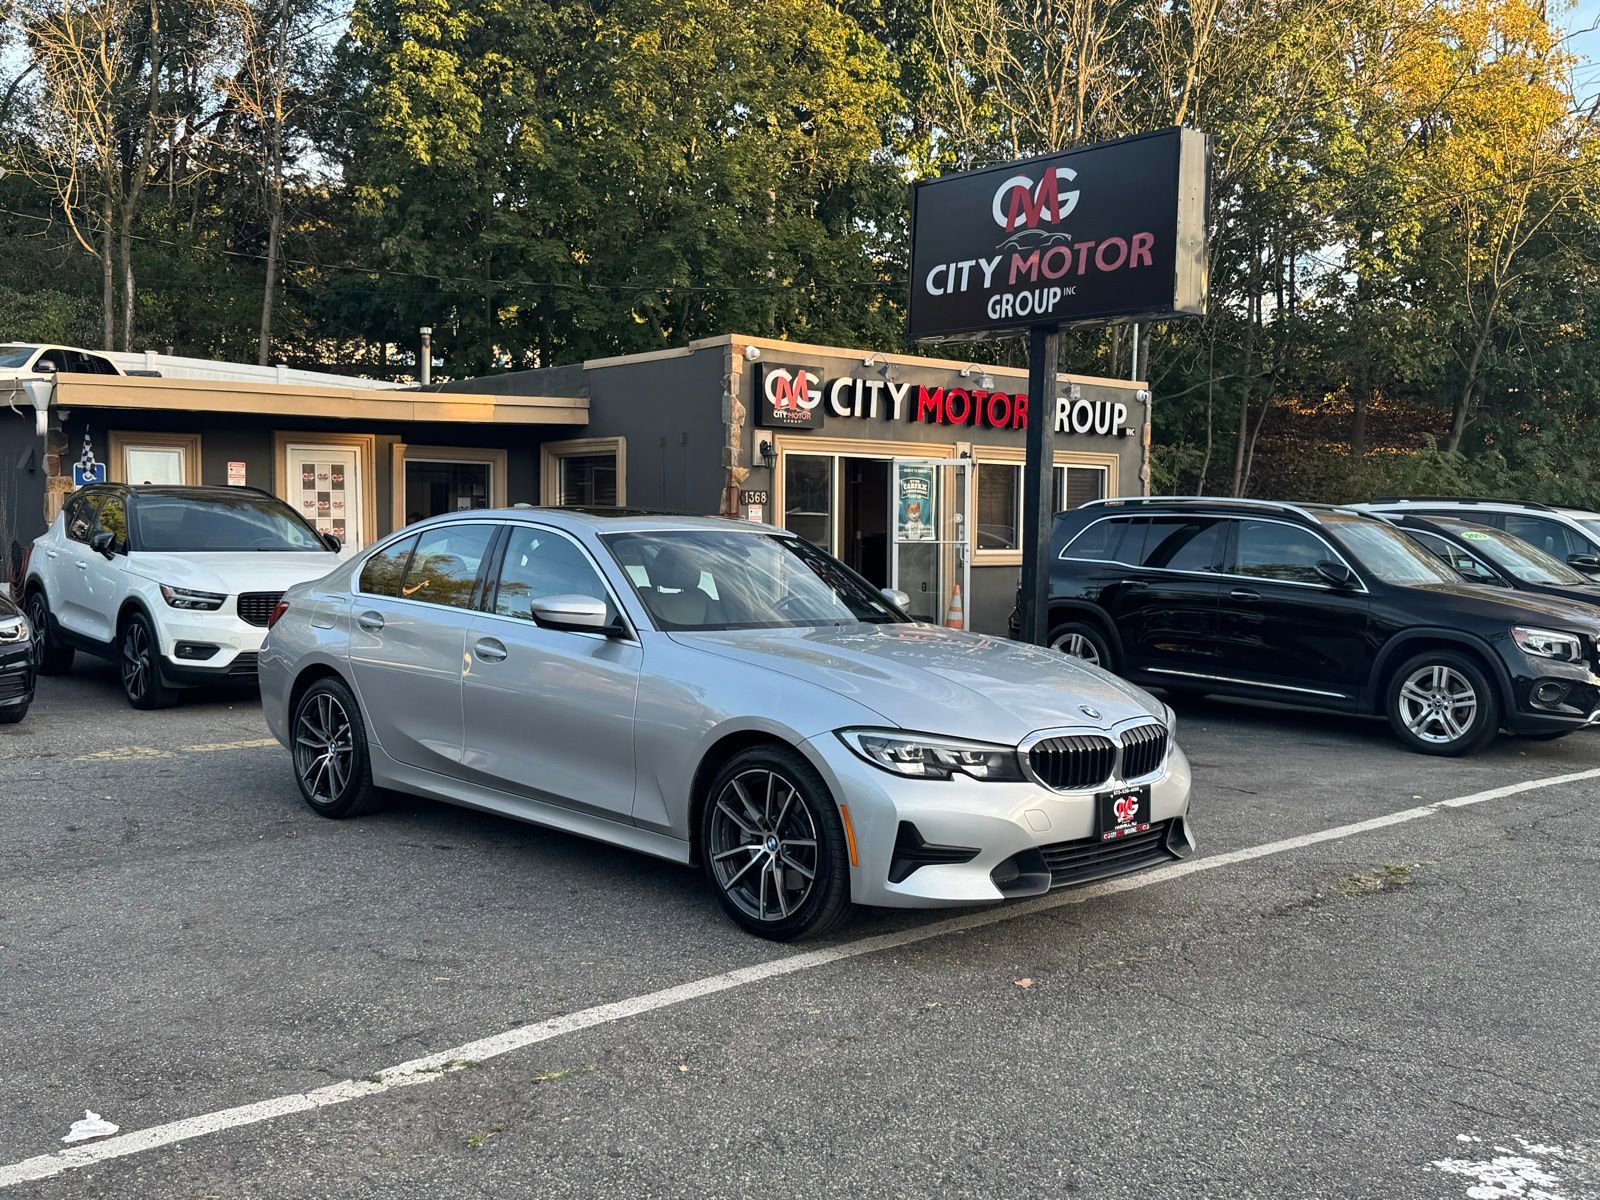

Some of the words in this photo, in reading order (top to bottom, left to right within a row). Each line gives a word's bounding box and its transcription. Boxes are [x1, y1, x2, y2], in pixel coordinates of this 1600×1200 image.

[926, 254, 1004, 296] CITY
[1008, 232, 1155, 285] MOTOR
[987, 286, 1062, 320] GROUP
[1063, 285, 1077, 296] INC
[831, 376, 911, 420] CITY
[917, 384, 1029, 430] MOTOR
[1054, 397, 1128, 436] ROUP
[745, 491, 767, 504] 1368
